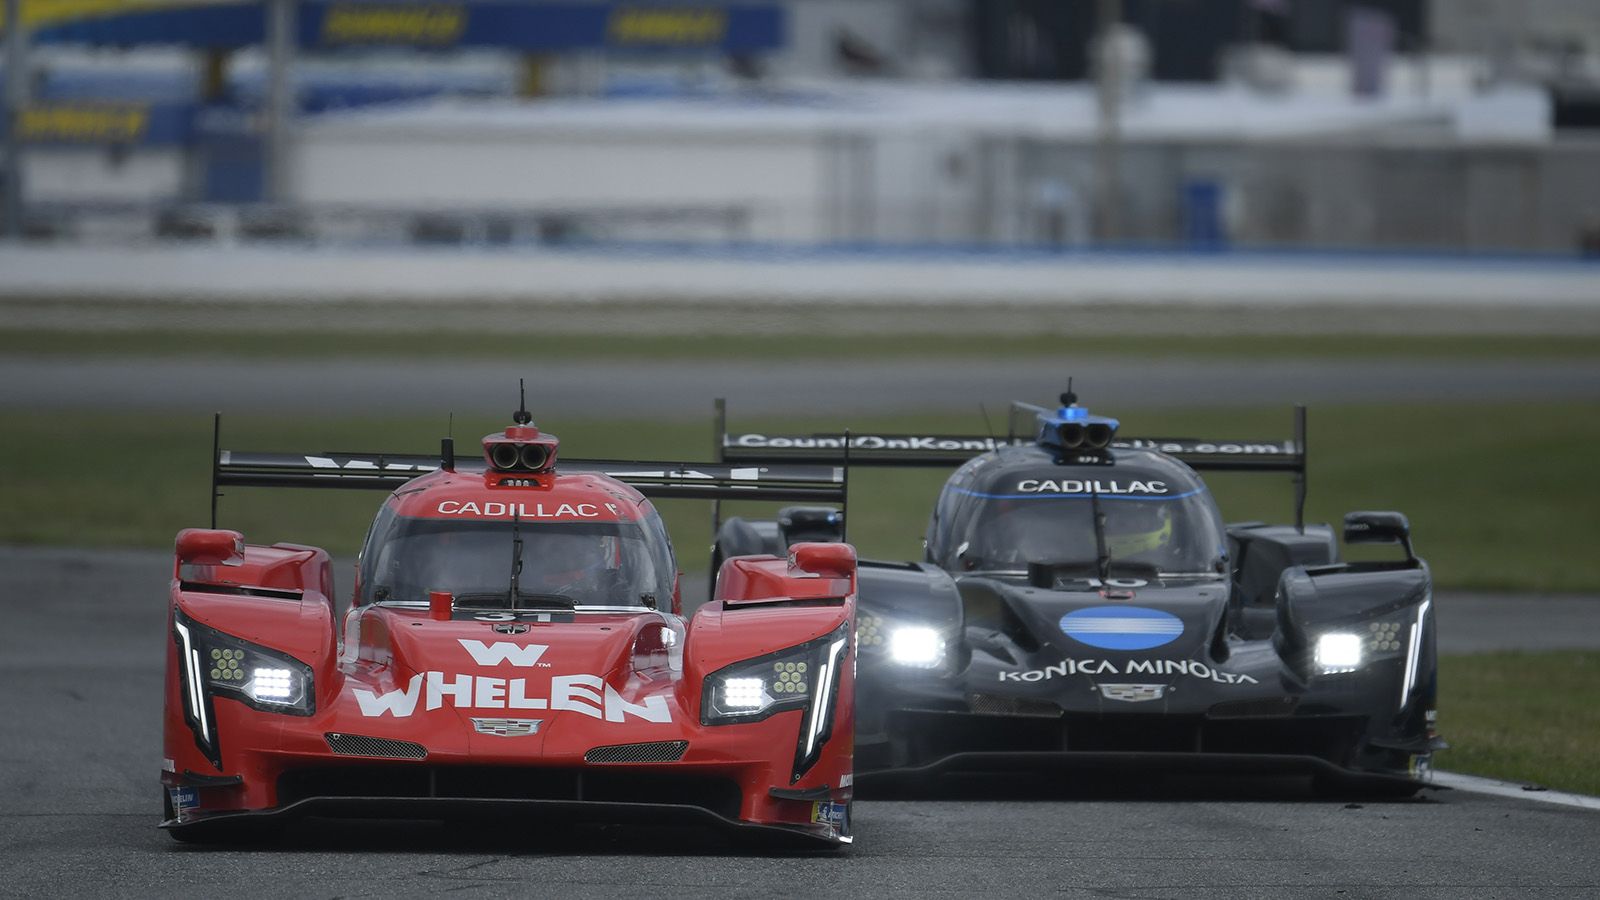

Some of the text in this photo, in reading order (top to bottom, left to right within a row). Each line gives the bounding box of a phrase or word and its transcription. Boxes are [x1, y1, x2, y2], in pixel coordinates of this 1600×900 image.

[1017, 480, 1169, 494] CADILLAC
[437, 500, 598, 518] CADILLAC
[473, 611, 551, 622] 31
[998, 658, 1260, 685] KONICA MINOLTA
[351, 671, 673, 724] WHELEN
